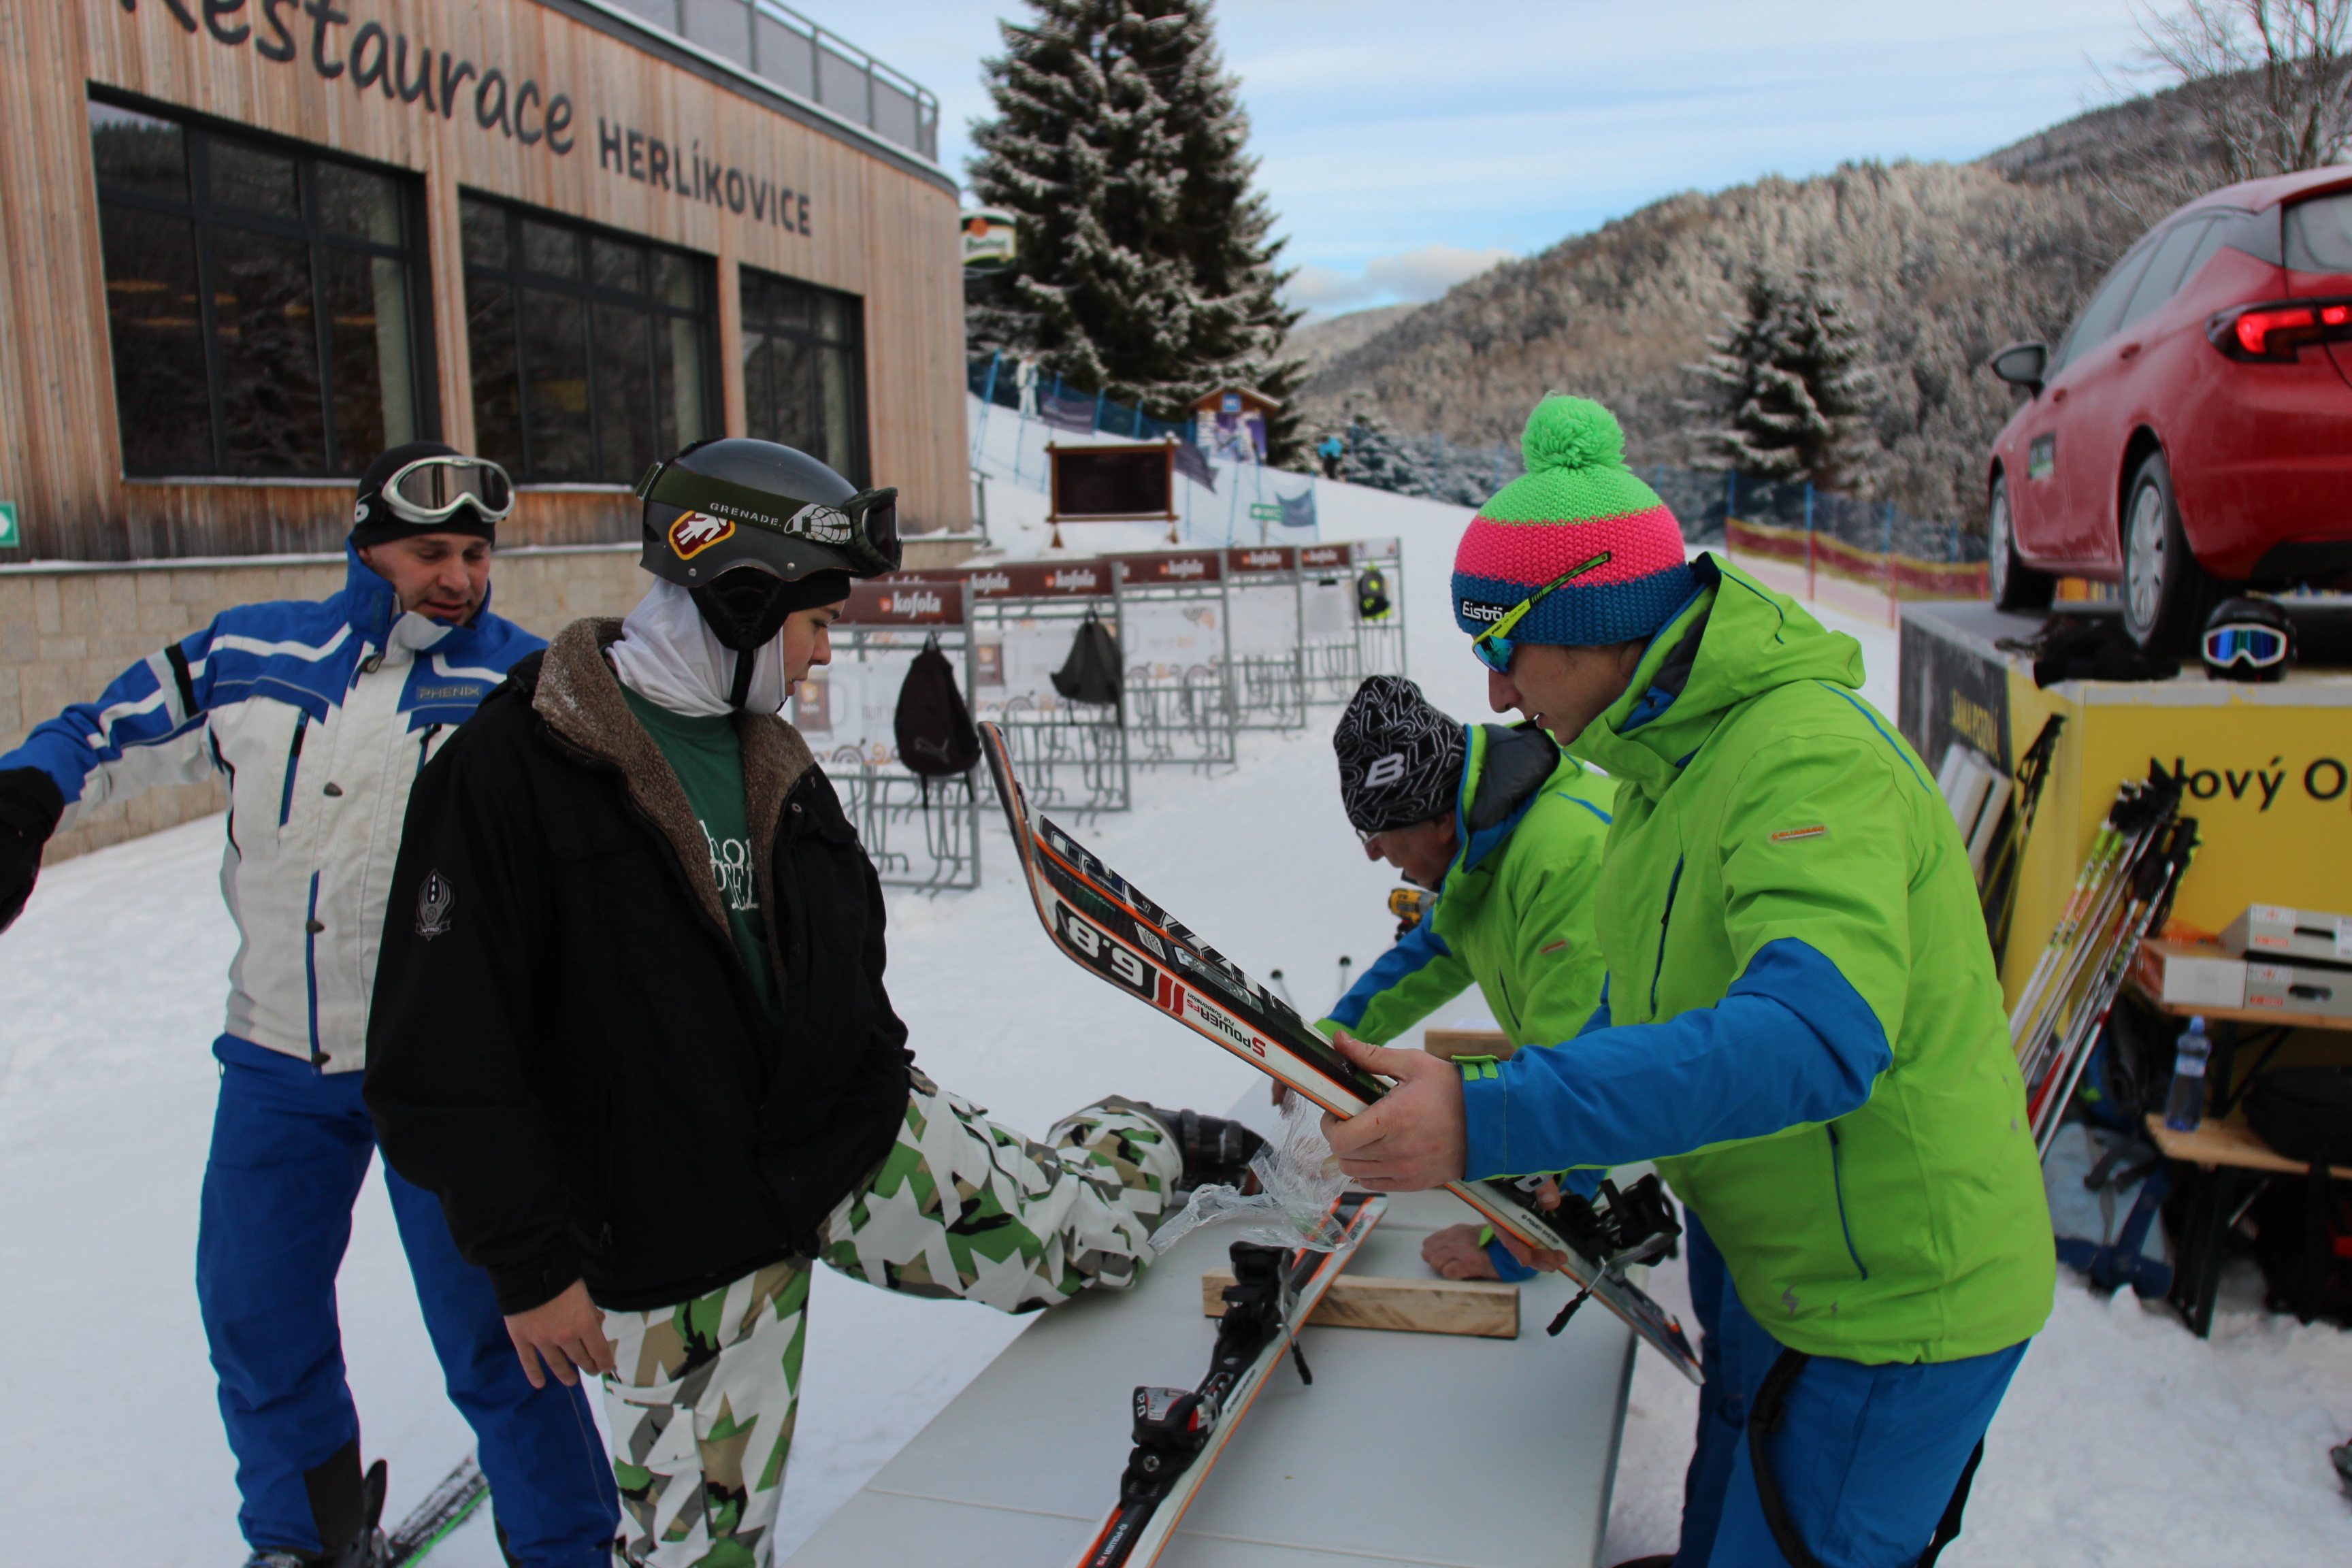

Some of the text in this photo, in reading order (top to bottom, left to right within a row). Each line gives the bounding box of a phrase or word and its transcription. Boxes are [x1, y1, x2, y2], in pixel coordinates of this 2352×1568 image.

[598, 117, 811, 237] HERLÍKOVICE
[1169, 559, 1205, 578] kofola
[1250, 550, 1281, 568] kofola
[970, 572, 1010, 595] kofola
[1056, 570, 1096, 592] kofola
[892, 591, 942, 619] kofola
[419, 686, 479, 698] PHENIX
[1365, 753, 1405, 787] B
[2149, 755, 2352, 813] Nový O
